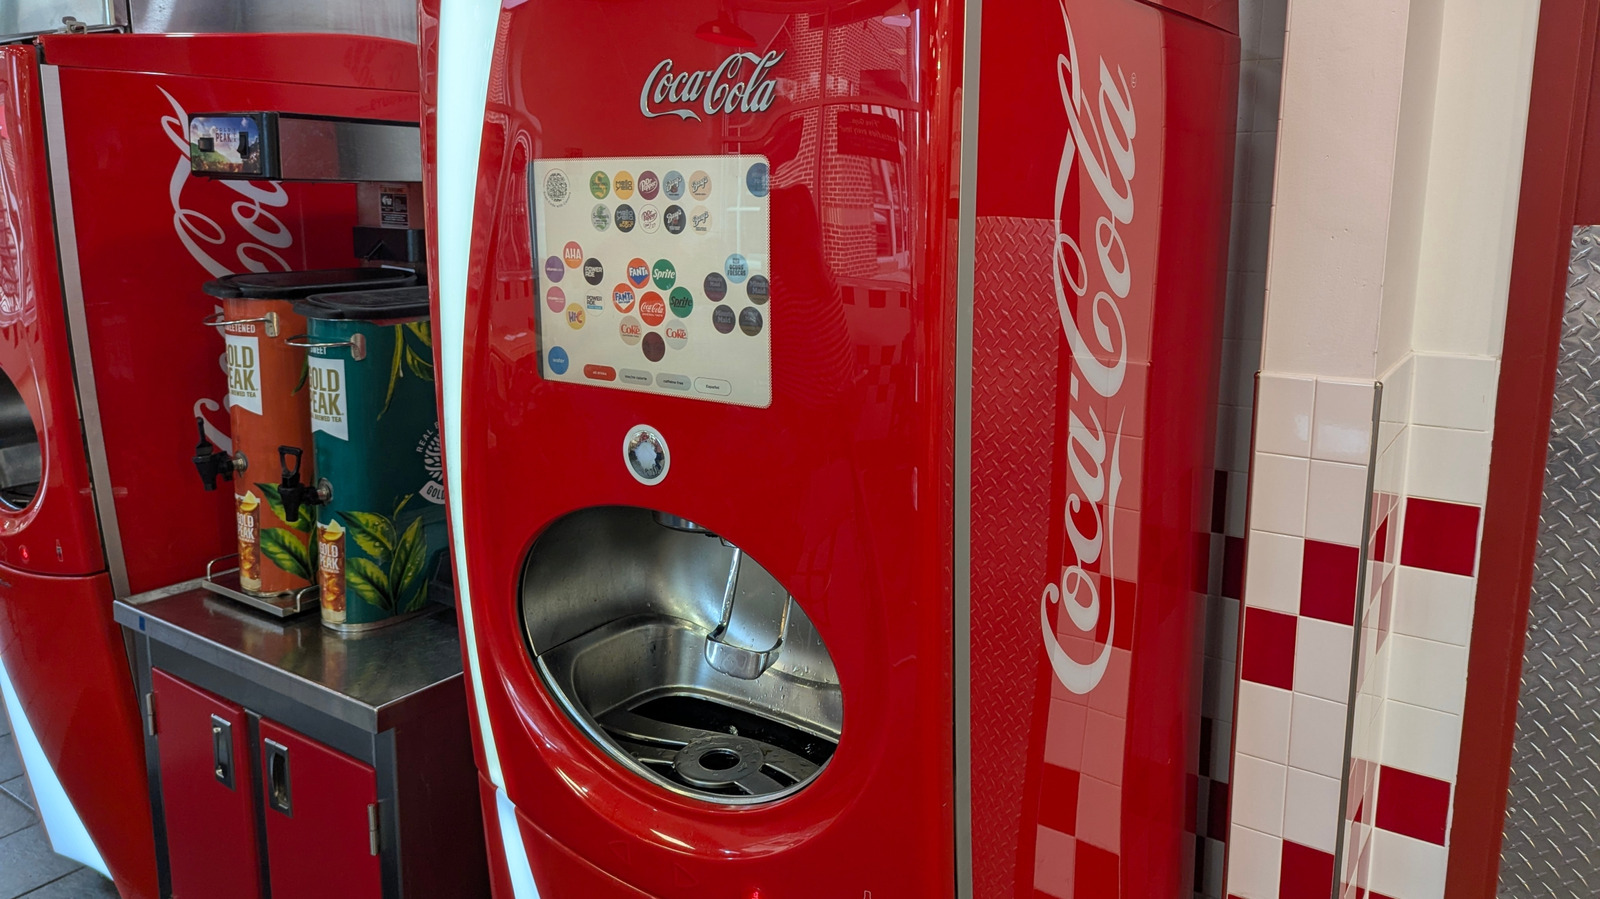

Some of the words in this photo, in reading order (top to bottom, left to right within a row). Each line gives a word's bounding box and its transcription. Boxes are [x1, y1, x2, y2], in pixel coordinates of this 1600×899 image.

[639, 49, 786, 122] Coca-Cola
[215, 133, 232, 143] PEAK
[565, 247, 582, 260] AHA
[652, 268, 675, 280] Sprite
[641, 302, 664, 314] Coca-Cola
[670, 296, 693, 308] Sprite
[620, 324, 640, 335] Coke
[665, 328, 687, 339] Coke
[1040, 0, 1137, 695] Coca-Cola
[227, 343, 255, 369] OLD
[229, 366, 256, 391] EAK
[416, 429, 434, 453] REAL
